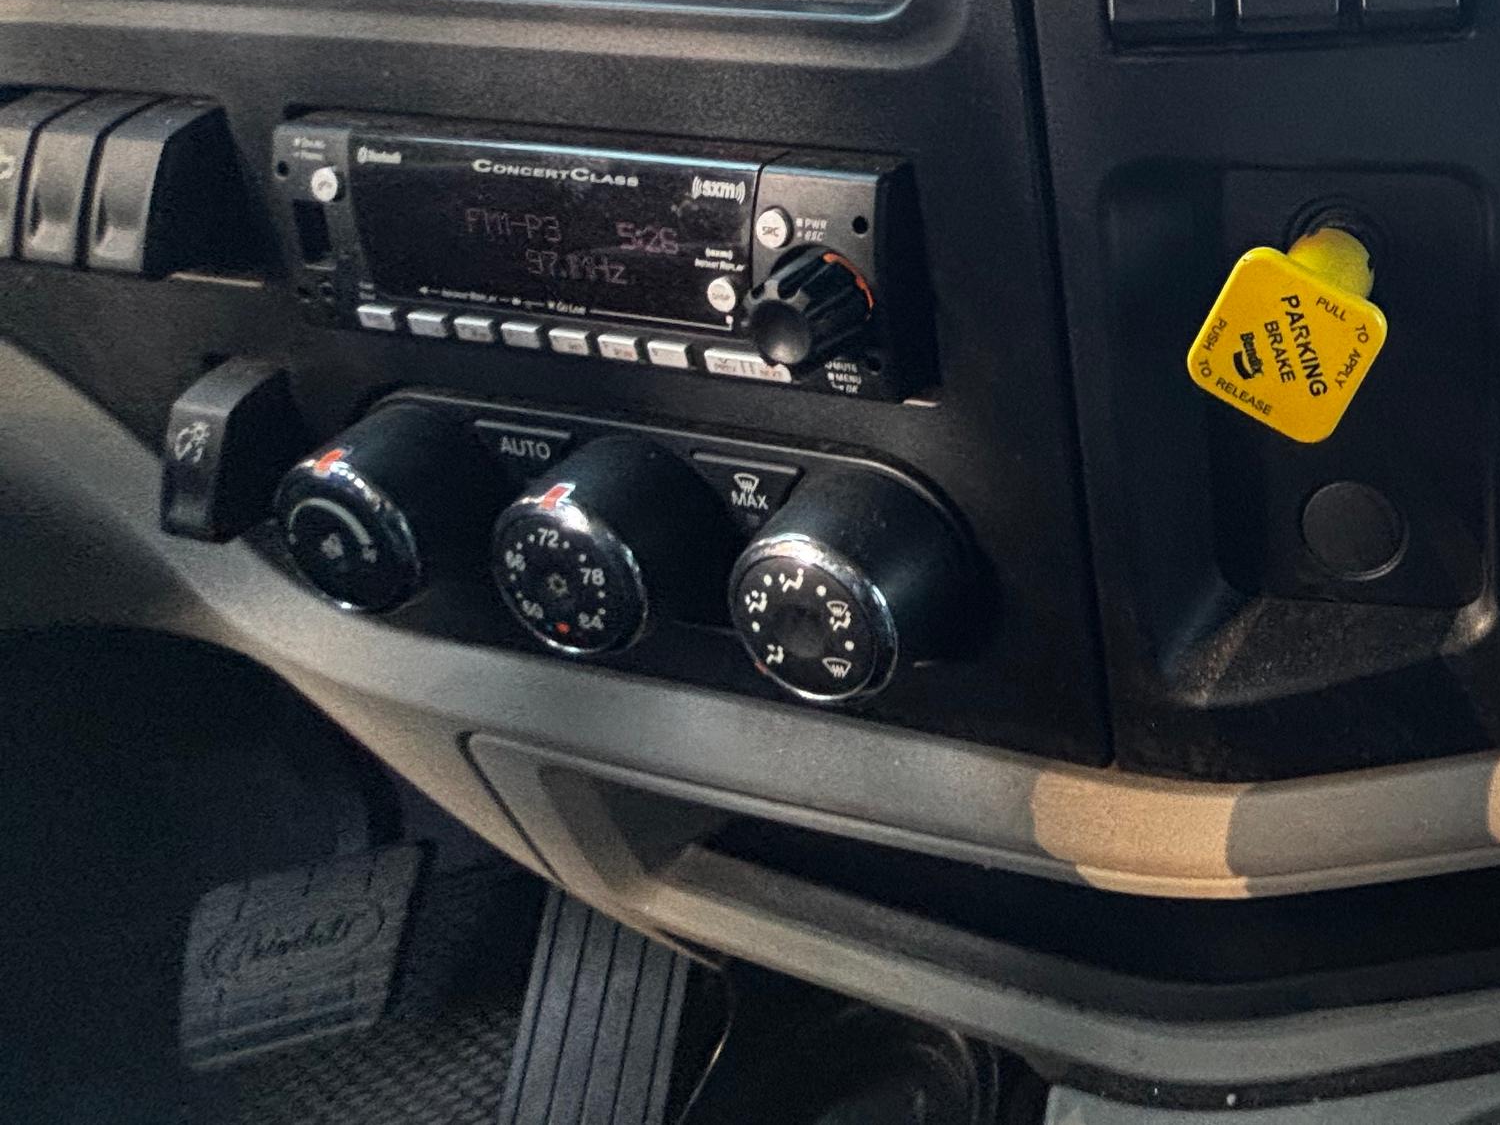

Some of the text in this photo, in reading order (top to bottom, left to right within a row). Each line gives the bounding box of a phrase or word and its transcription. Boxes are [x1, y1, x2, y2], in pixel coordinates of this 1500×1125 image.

[1315, 296, 1347, 322] PULL
[1203, 318, 1228, 352] PUSH
[1281, 294, 1328, 398] PARKING
[1355, 323, 1369, 345] TO
[1264, 320, 1296, 384] BRAKE
[1198, 359, 1212, 378] TO
[1335, 348, 1362, 389] APPLY
[1215, 377, 1273, 415] RELEASE
[500, 435, 550, 460] AUTO
[731, 490, 769, 511] MAX
[537, 527, 560, 548] 72
[579, 567, 606, 587] 78
